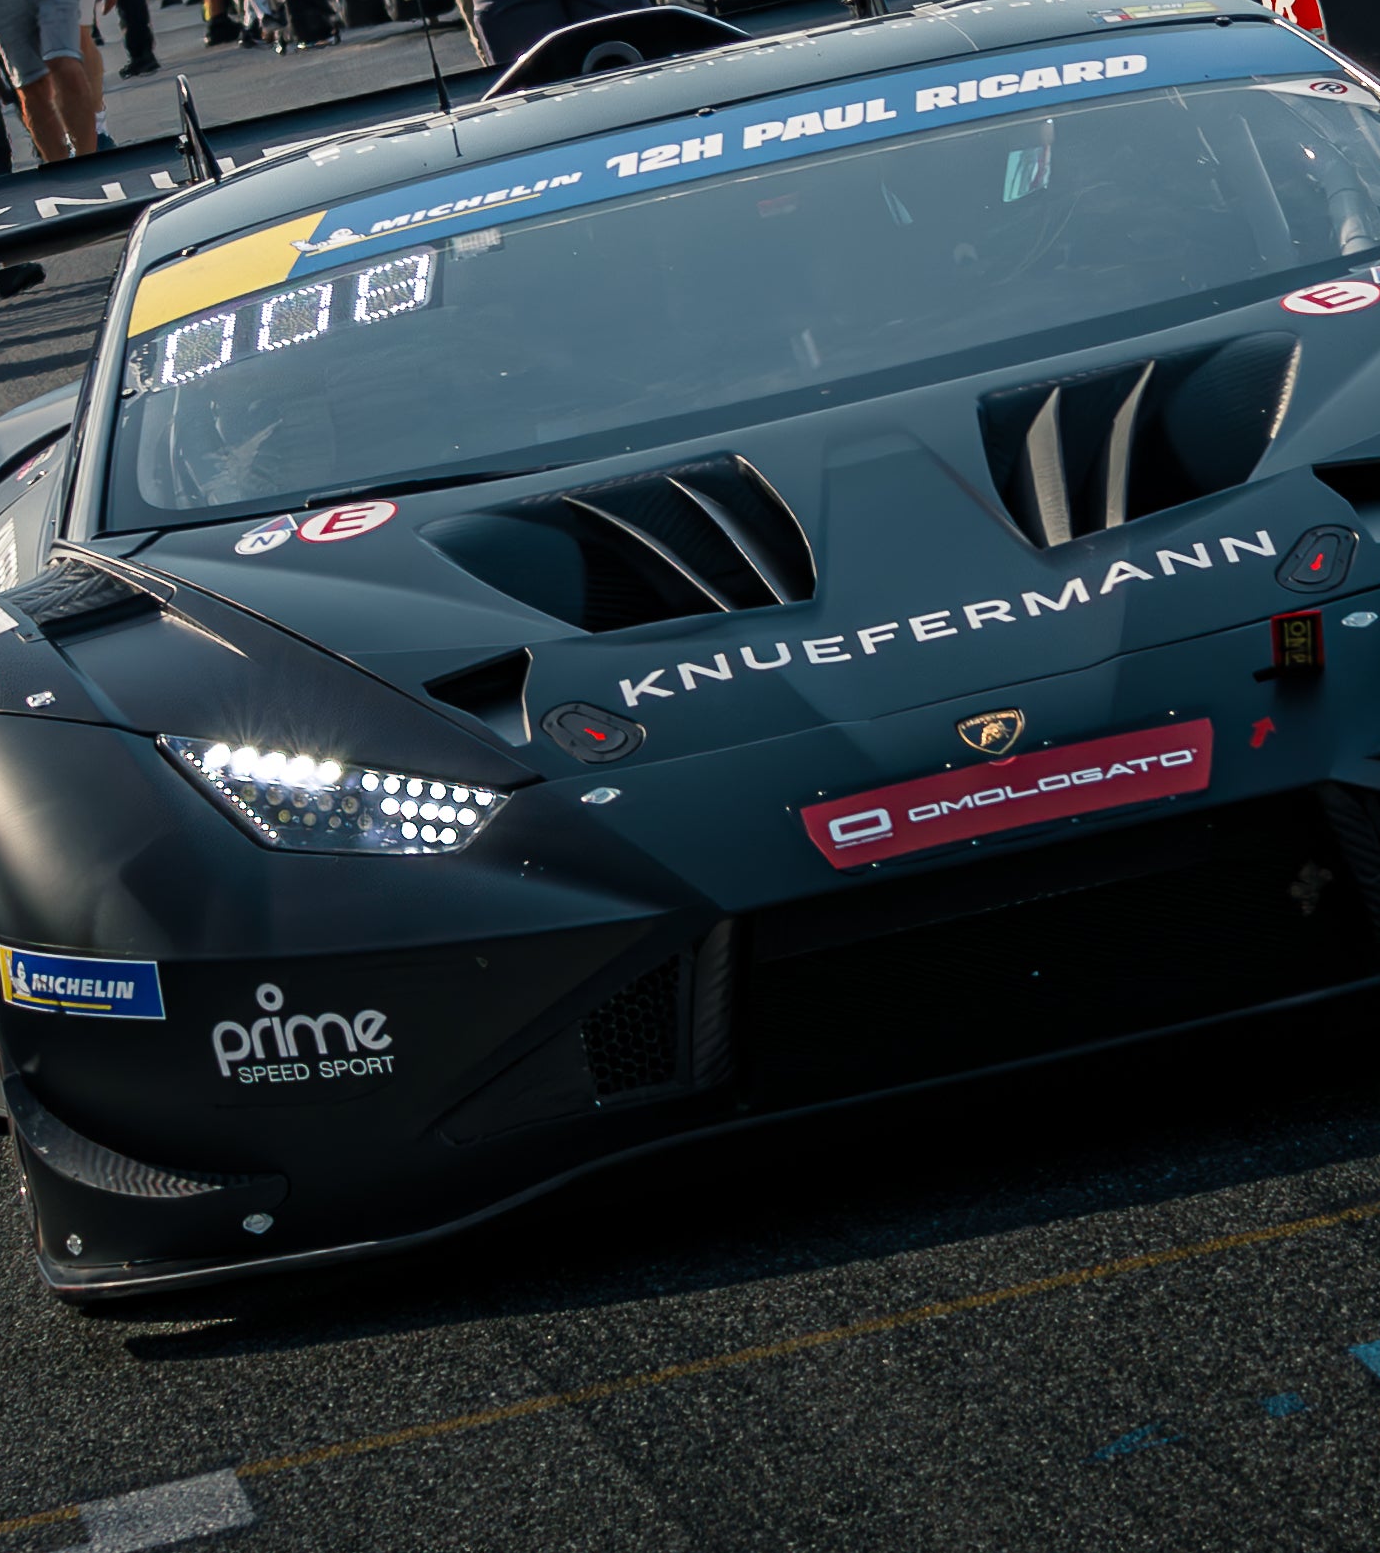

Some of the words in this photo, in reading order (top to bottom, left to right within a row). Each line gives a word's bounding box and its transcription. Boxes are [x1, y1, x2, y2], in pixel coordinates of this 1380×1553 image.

[370, 172, 583, 236] MICHELIN
[606, 133, 724, 180] 12H
[743, 97, 897, 151] PAUL
[915, 52, 1147, 114] RICARD
[619, 529, 1278, 708] KNUEFERMANN
[908, 748, 1194, 823] OMOLOGATO
[32, 973, 135, 1001] MICHELIN
[212, 982, 394, 1078] prime
[237, 1059, 310, 1085] SPEED
[319, 1055, 396, 1080] SPORT
